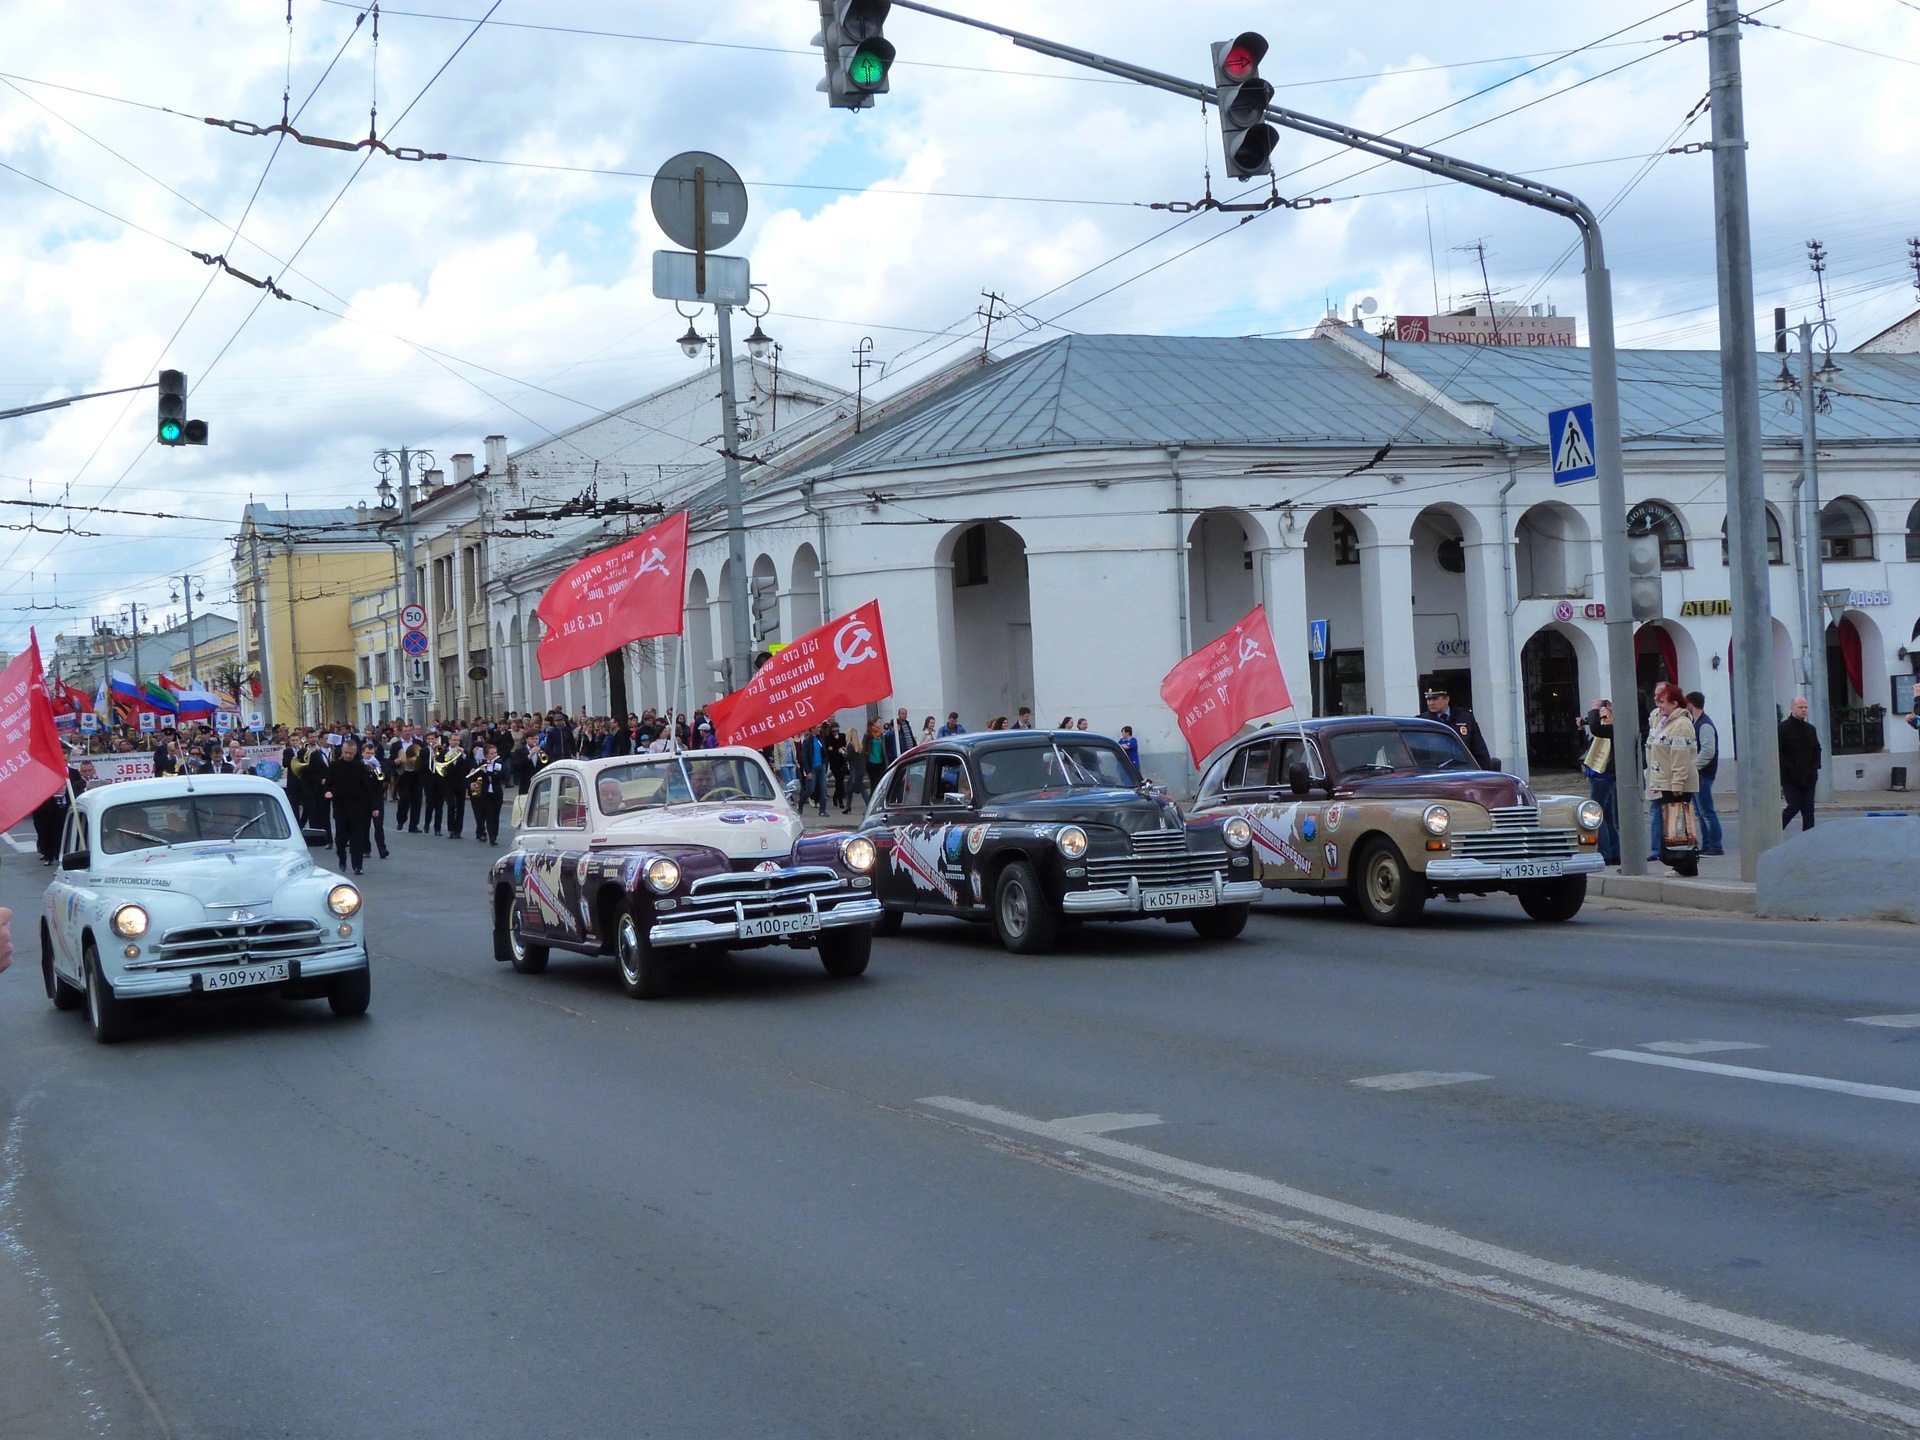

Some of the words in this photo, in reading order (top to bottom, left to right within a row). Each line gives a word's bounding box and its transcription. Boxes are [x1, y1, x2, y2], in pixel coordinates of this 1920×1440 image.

[1458, 320, 1547, 328] КОМПЛЕКС
[1584, 603, 1606, 619] СВ
[406, 612, 422, 622] 50
